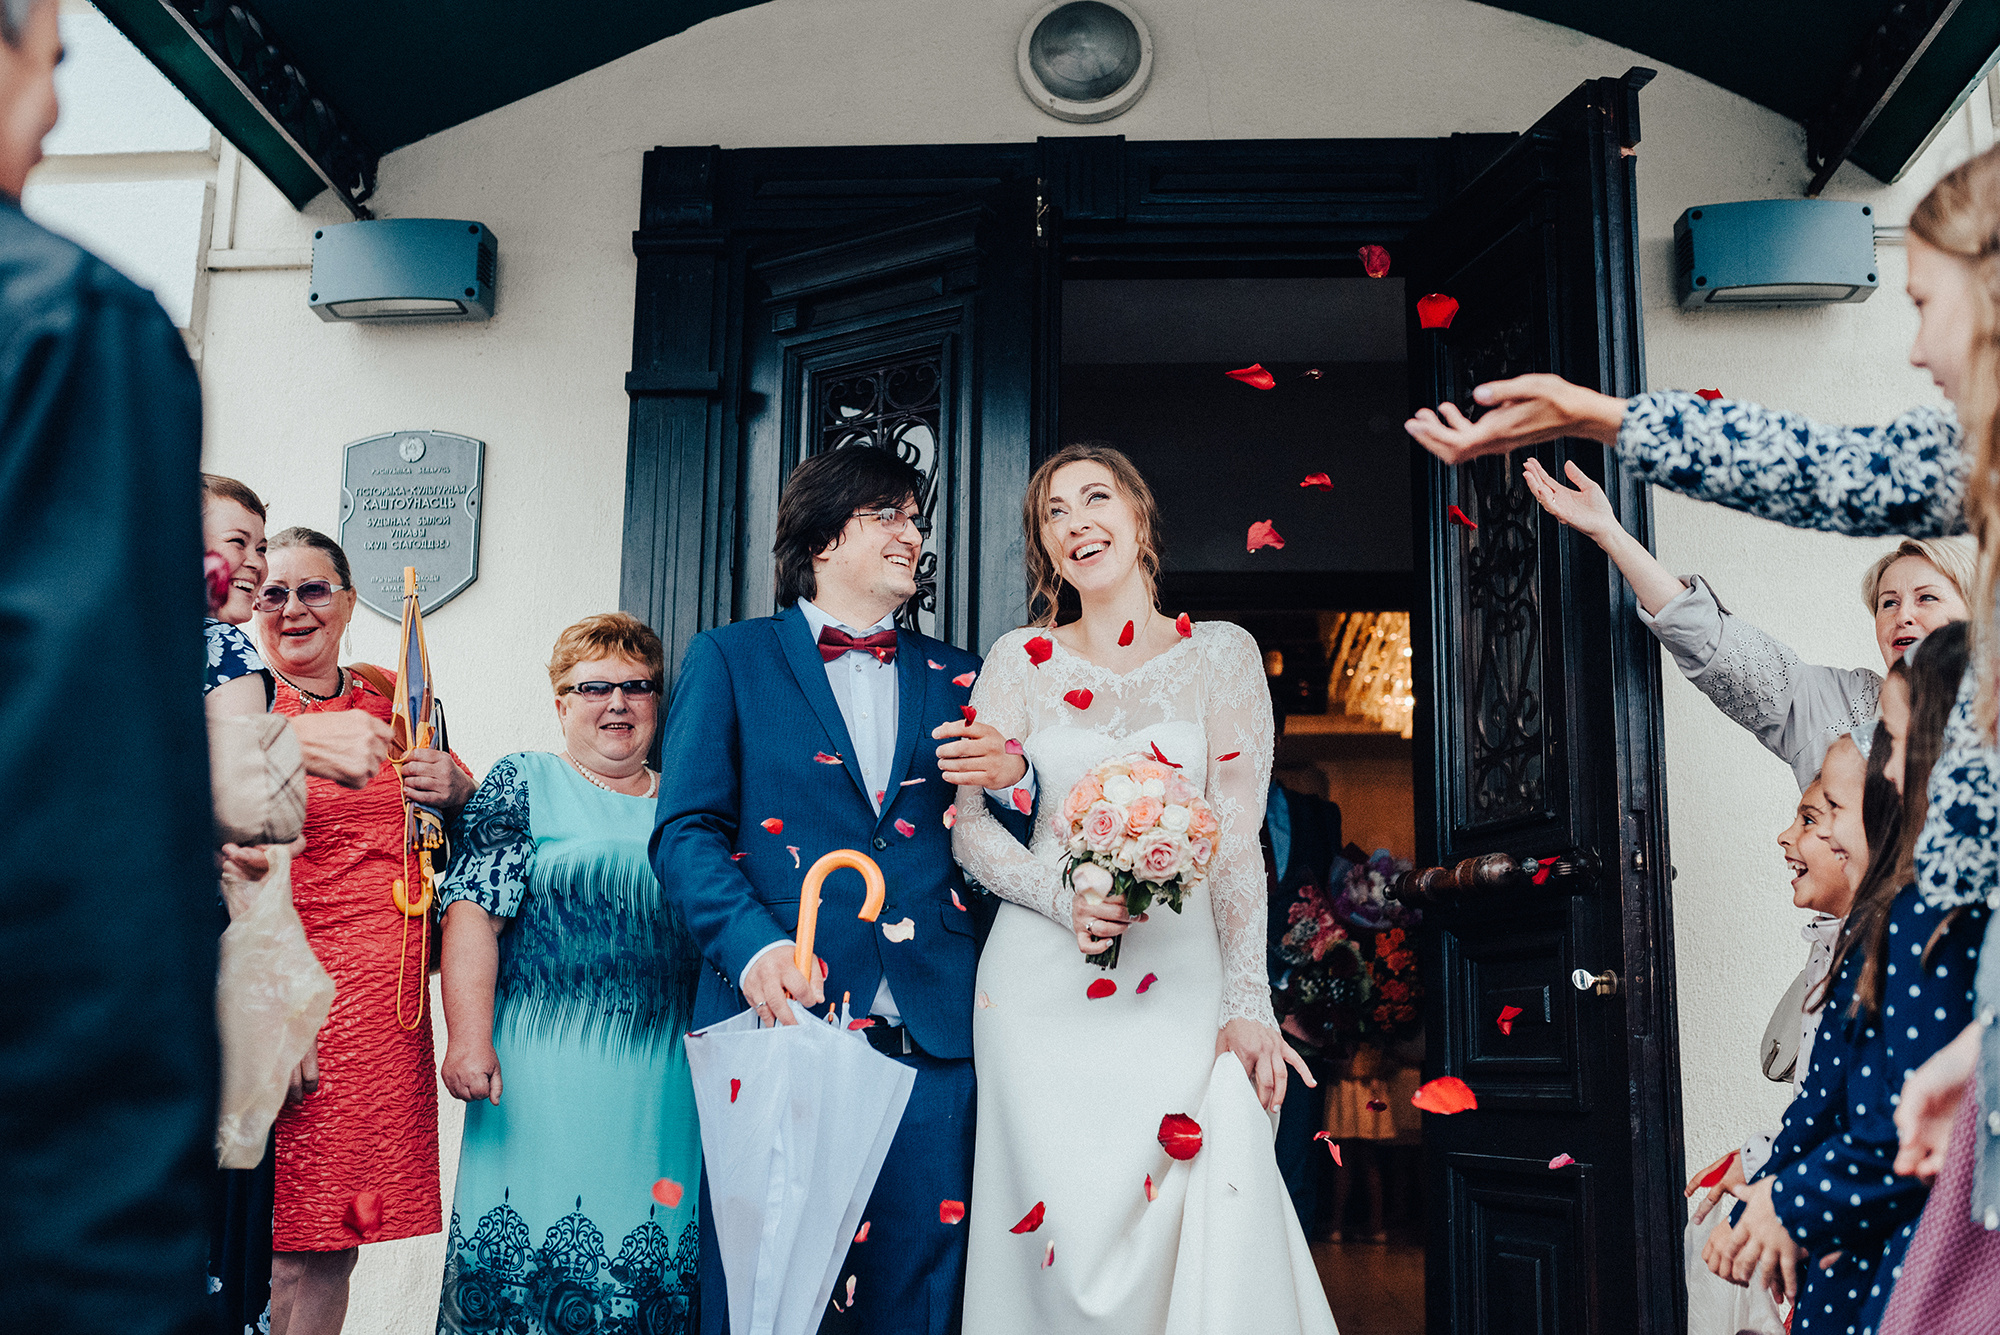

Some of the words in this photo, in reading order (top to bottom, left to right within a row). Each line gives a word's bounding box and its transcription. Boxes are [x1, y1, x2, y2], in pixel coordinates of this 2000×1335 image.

[356, 485, 467, 497] ГІСТОРЫКА-КУЛЬТУРНАЯ
[363, 496, 456, 511] КАШТОЎНАСЦЬ
[366, 516, 411, 528] БУДЫНАК
[416, 515, 451, 526] БЫЛОЙ
[390, 528, 427, 539] УПРАВЫ
